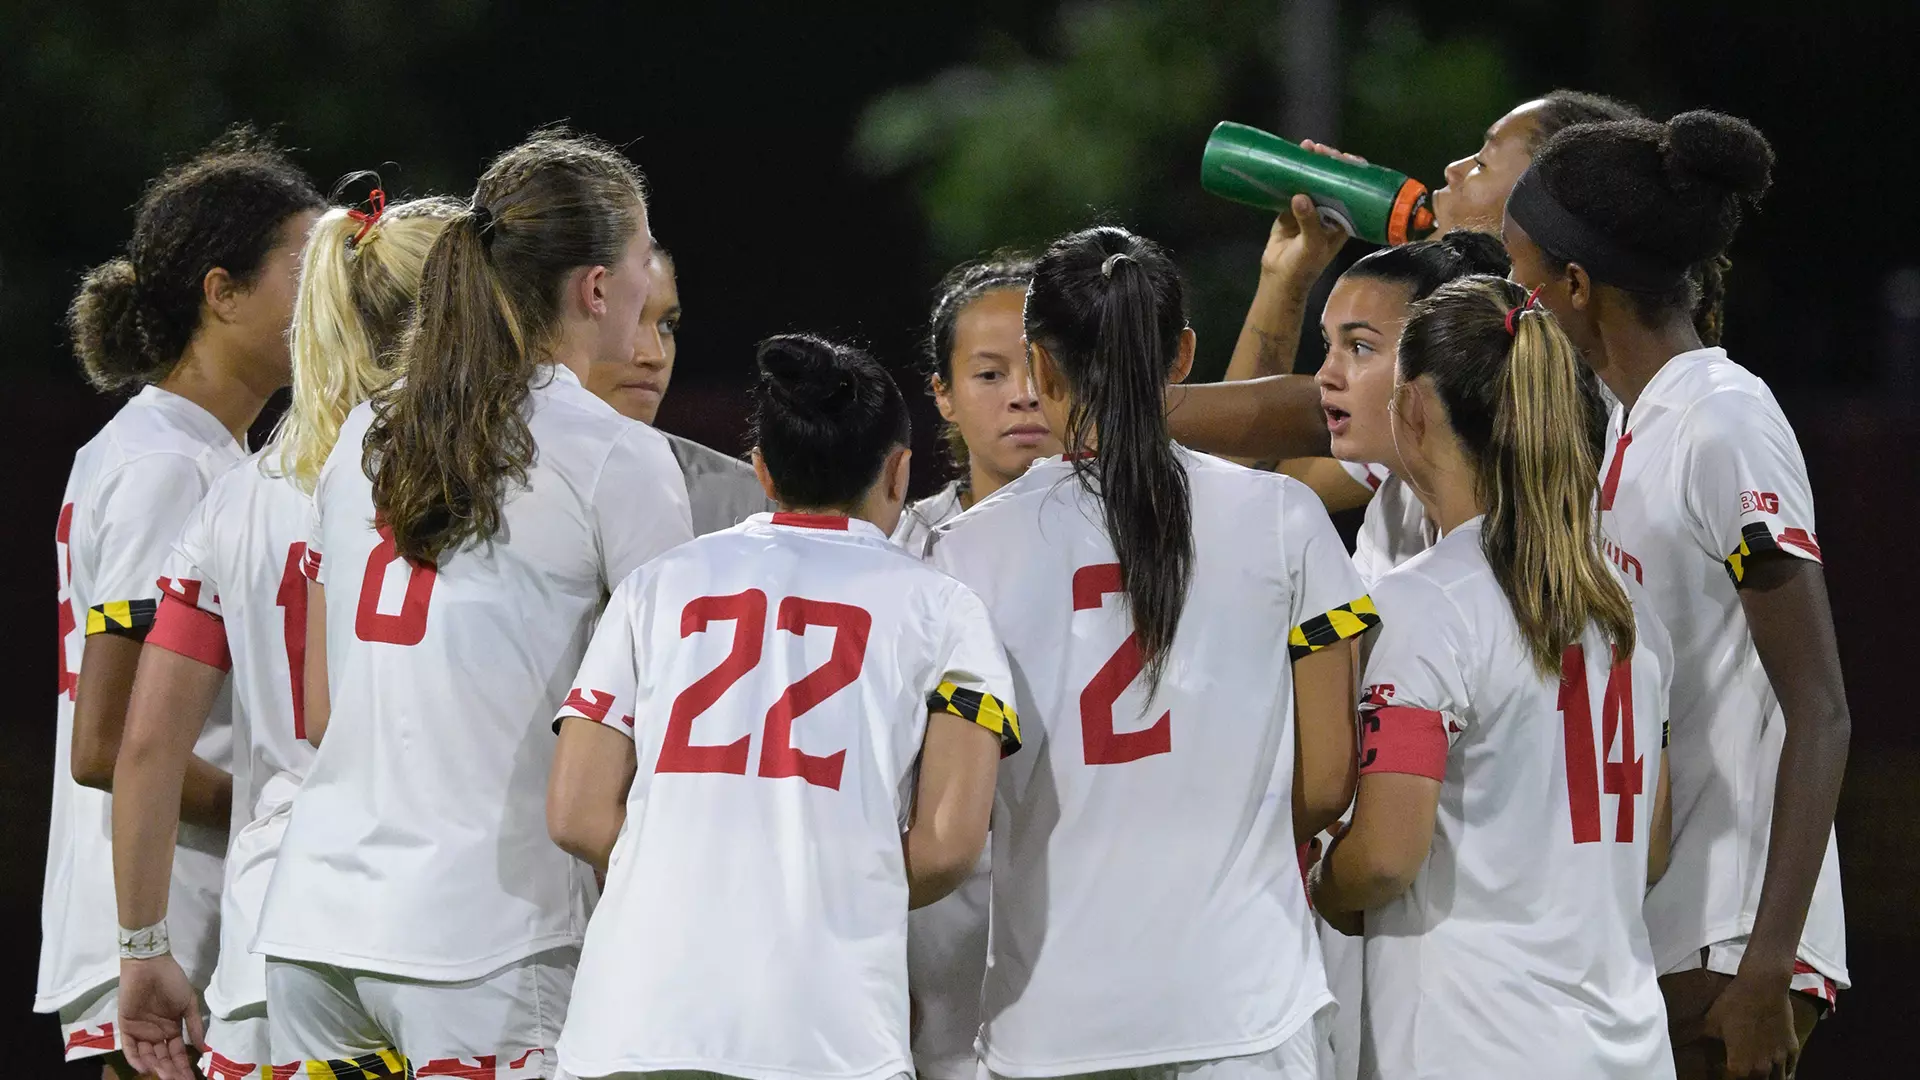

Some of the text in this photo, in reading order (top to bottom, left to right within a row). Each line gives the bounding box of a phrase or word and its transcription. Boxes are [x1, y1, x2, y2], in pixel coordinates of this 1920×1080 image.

[655, 589, 871, 790] 22
[1072, 563, 1171, 765] 2
[1557, 643, 1643, 844] 14
